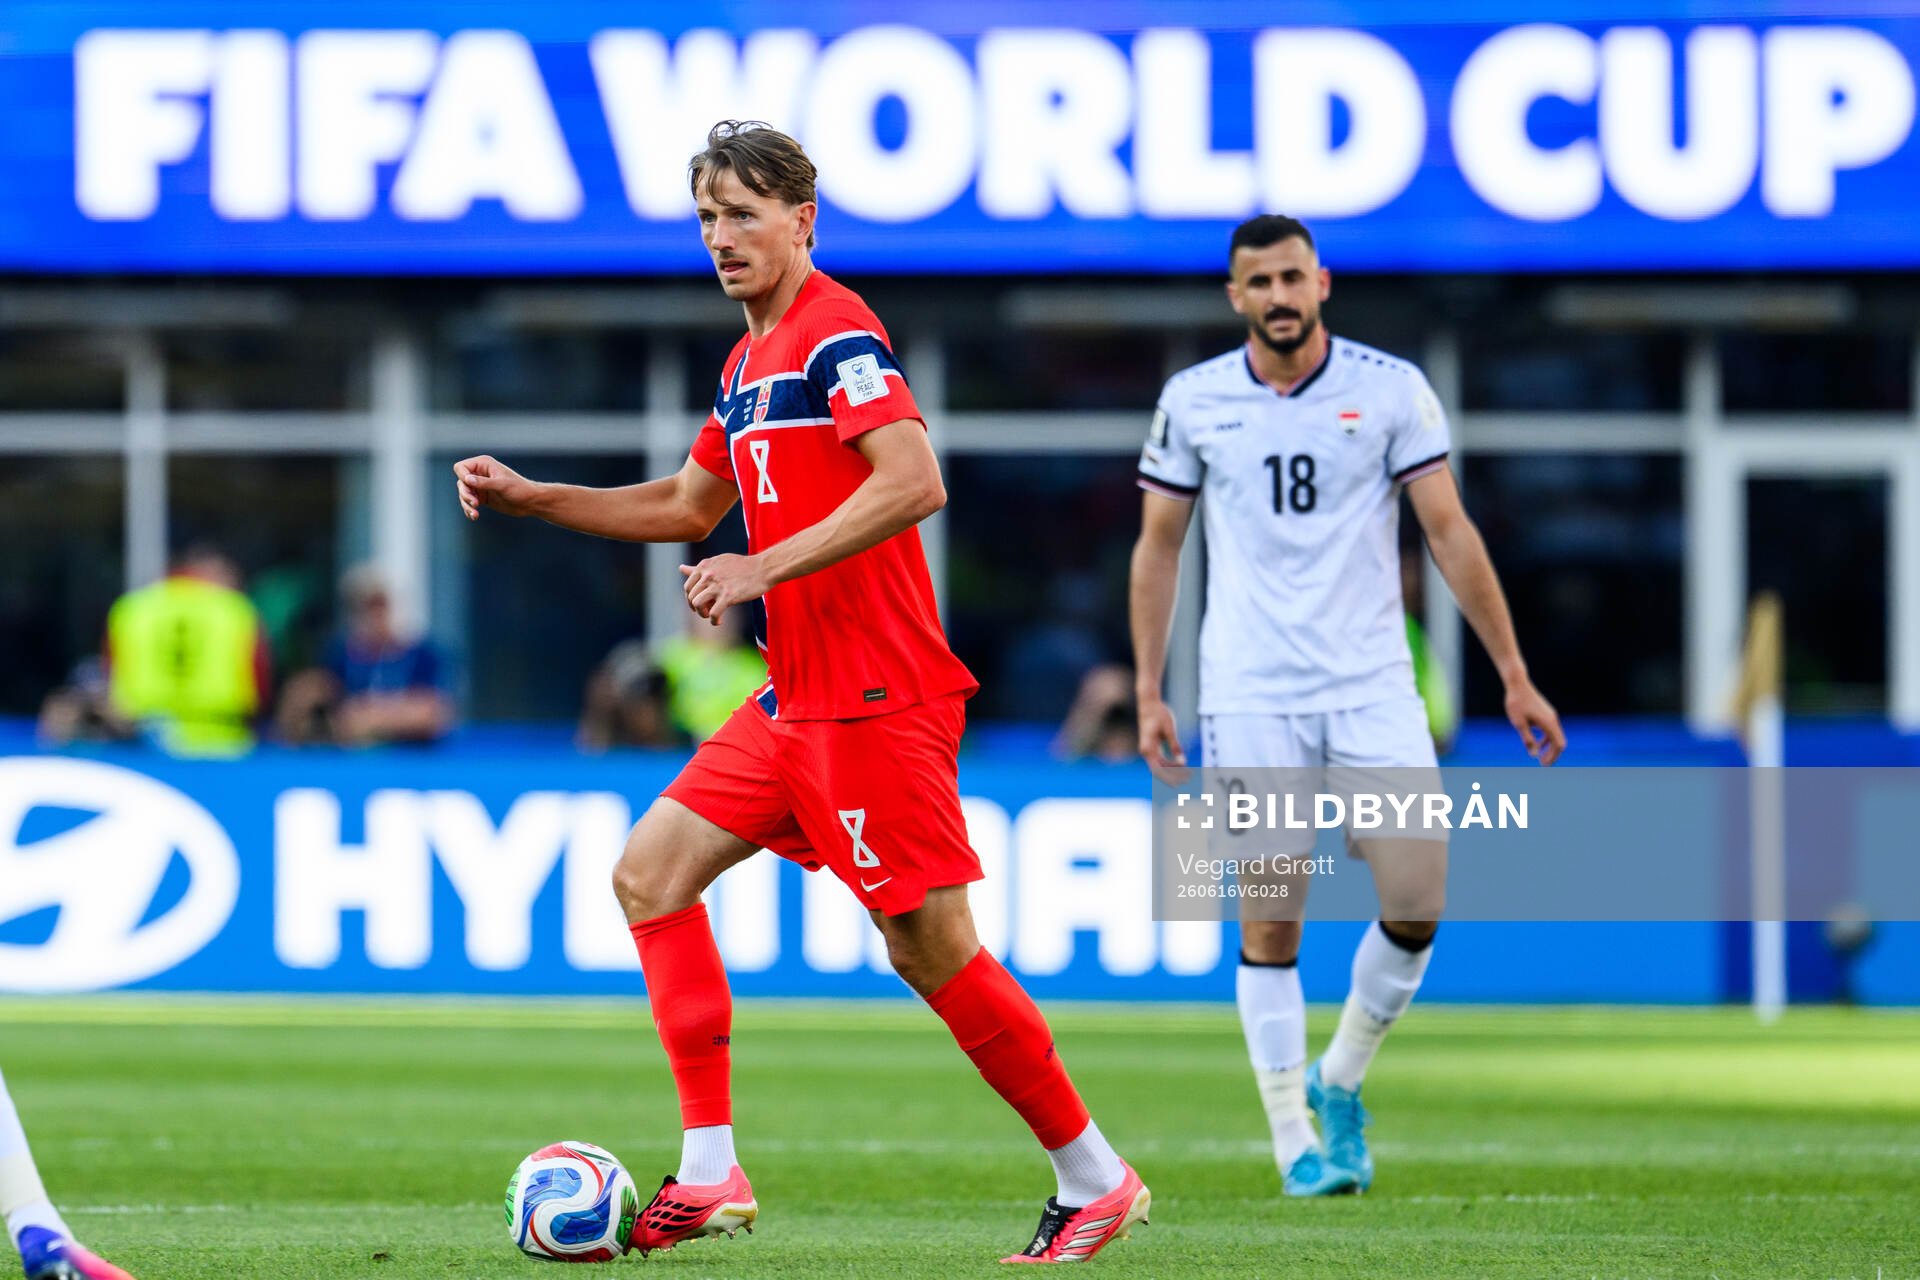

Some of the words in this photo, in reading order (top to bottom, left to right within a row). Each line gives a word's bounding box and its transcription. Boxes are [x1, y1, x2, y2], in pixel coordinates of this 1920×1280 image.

[74, 28, 585, 222] FIFA
[589, 24, 1427, 223] WORLD
[1449, 22, 1916, 222] CUP
[750, 440, 779, 504] 8
[1264, 454, 1317, 515] 18
[838, 808, 881, 868] 8
